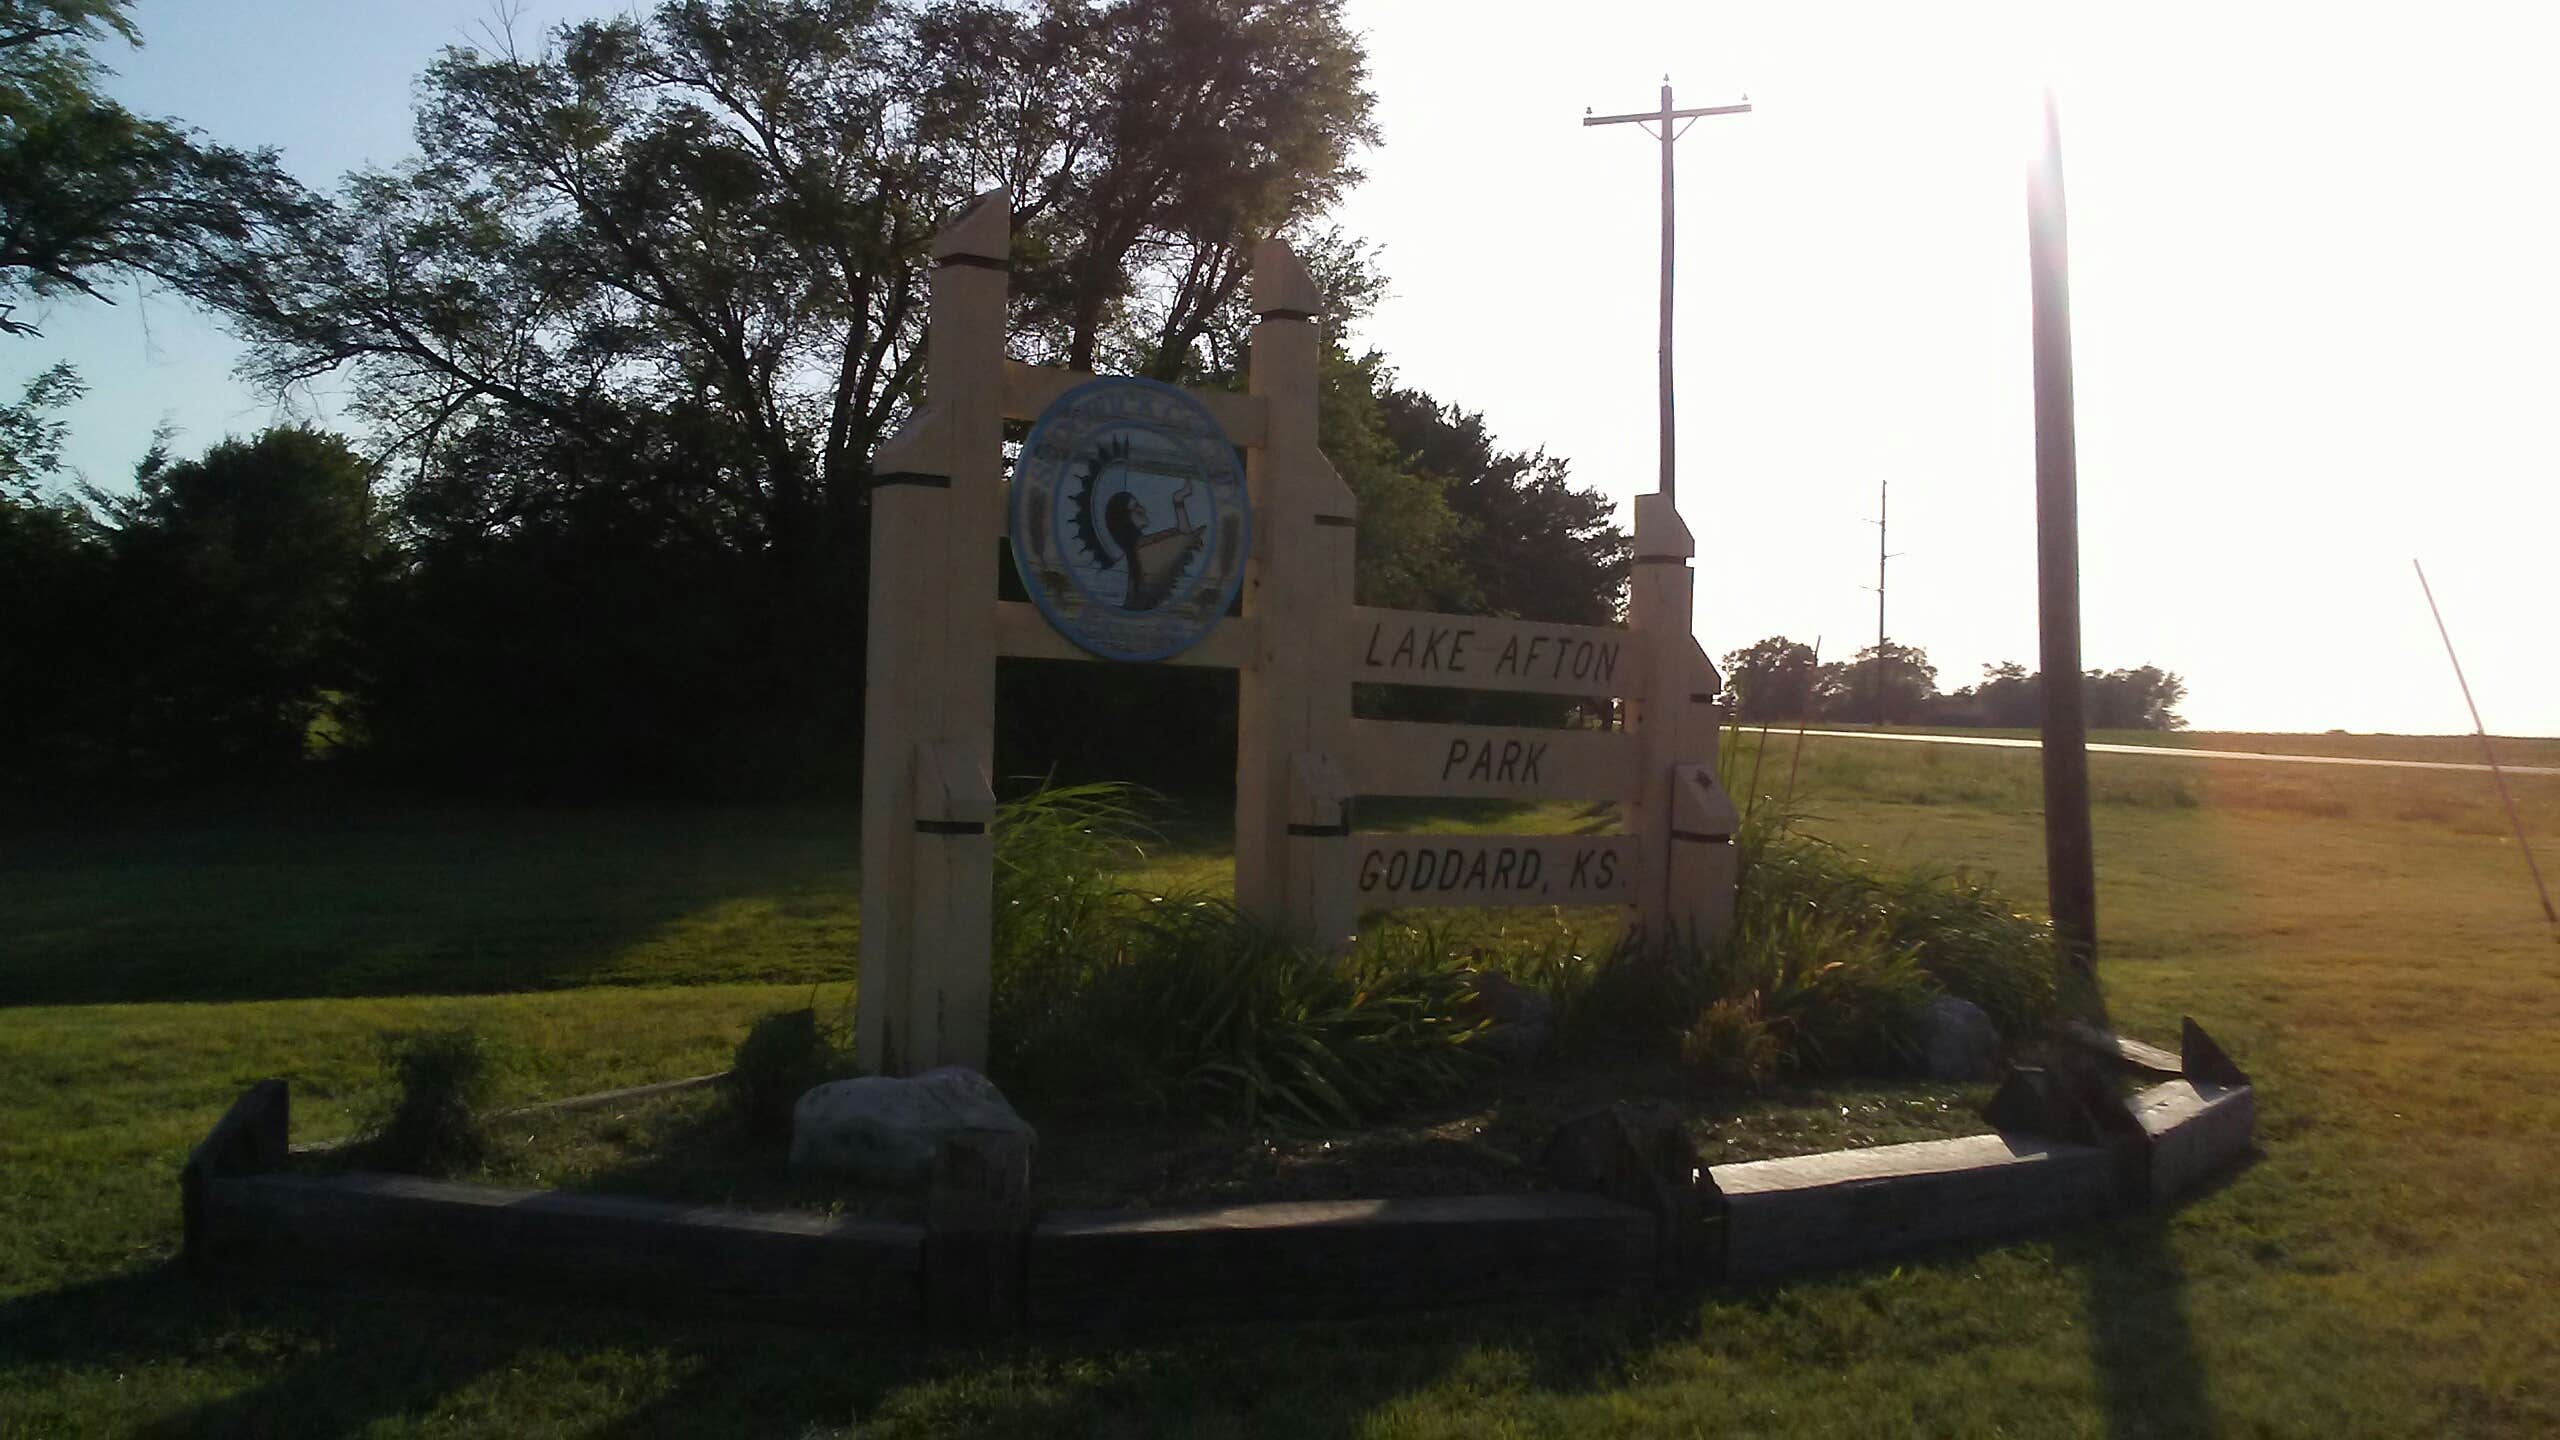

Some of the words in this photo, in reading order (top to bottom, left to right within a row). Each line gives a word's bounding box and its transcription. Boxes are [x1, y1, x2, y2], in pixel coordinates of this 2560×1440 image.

[1365, 622, 1475, 671] LAKE
[1496, 634, 1620, 682] AFTON
[1442, 739, 1548, 784] PARK
[1359, 849, 1548, 894] GODDARD,
